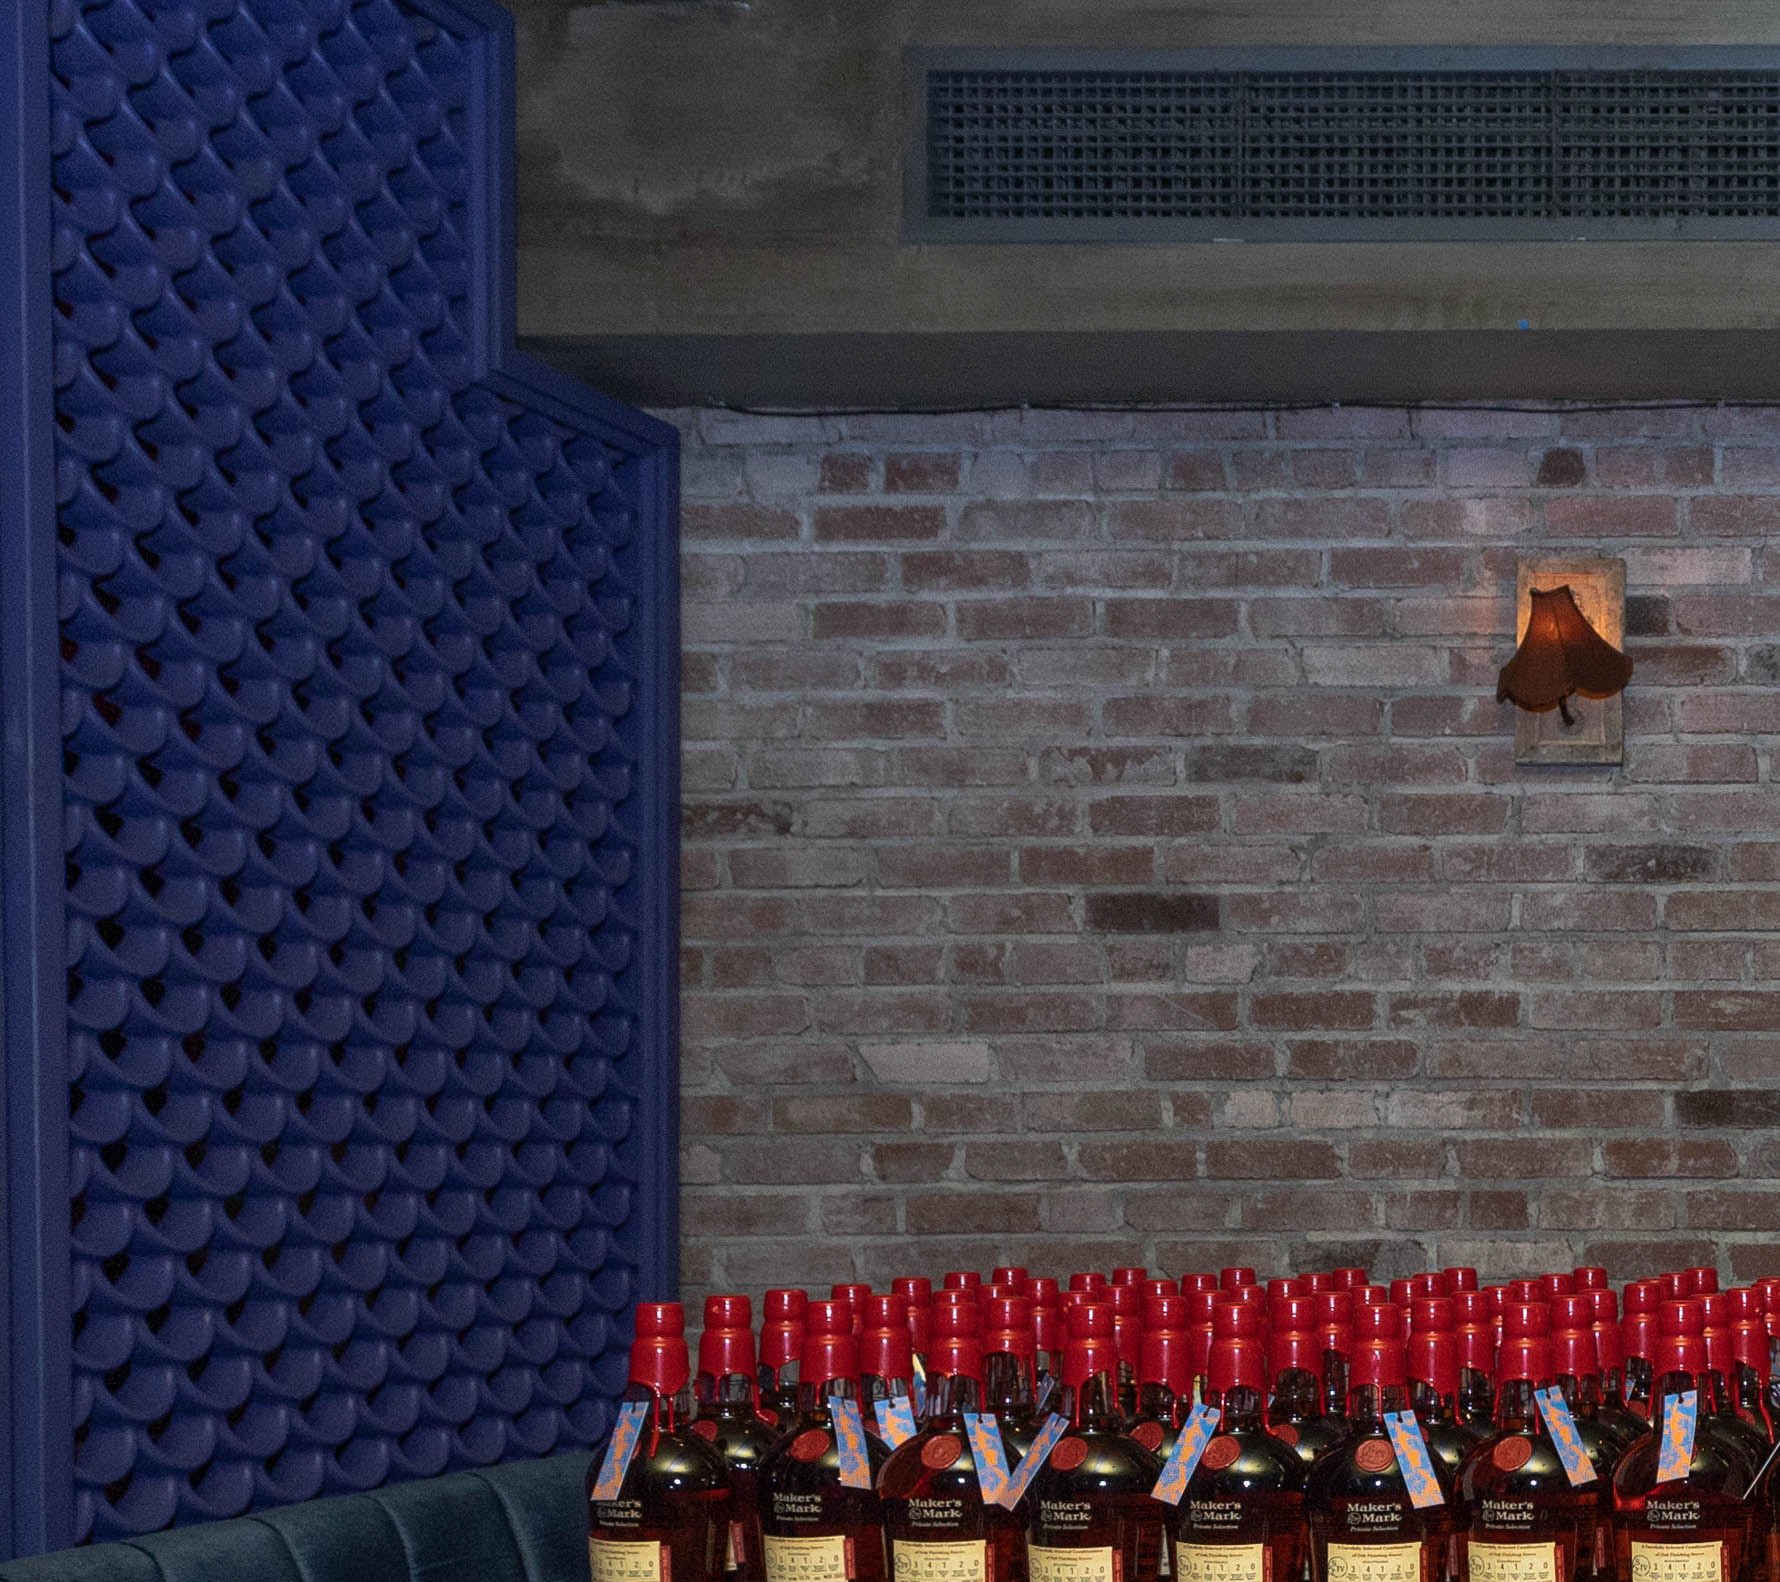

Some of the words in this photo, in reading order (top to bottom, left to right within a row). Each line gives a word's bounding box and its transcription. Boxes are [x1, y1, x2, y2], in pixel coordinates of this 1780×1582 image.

[773, 1493, 821, 1502] Maker's
[909, 1499, 961, 1507] Maker's
[1040, 1501, 1090, 1510] Maker's
[1190, 1501, 1241, 1510] Maker's
[1348, 1503, 1401, 1511] Maker's
[1482, 1501, 1533, 1510] Maker's
[1647, 1501, 1699, 1510] Maker's
[786, 1504, 820, 1512] Mark
[608, 1510, 639, 1518] Mark
[923, 1509, 960, 1517] Mark
[1054, 1512, 1089, 1520] Mark
[1203, 1512, 1240, 1520] Mark
[1496, 1512, 1533, 1520] Mark
[1661, 1512, 1698, 1520] Mark
[1363, 1514, 1400, 1522] Mark
